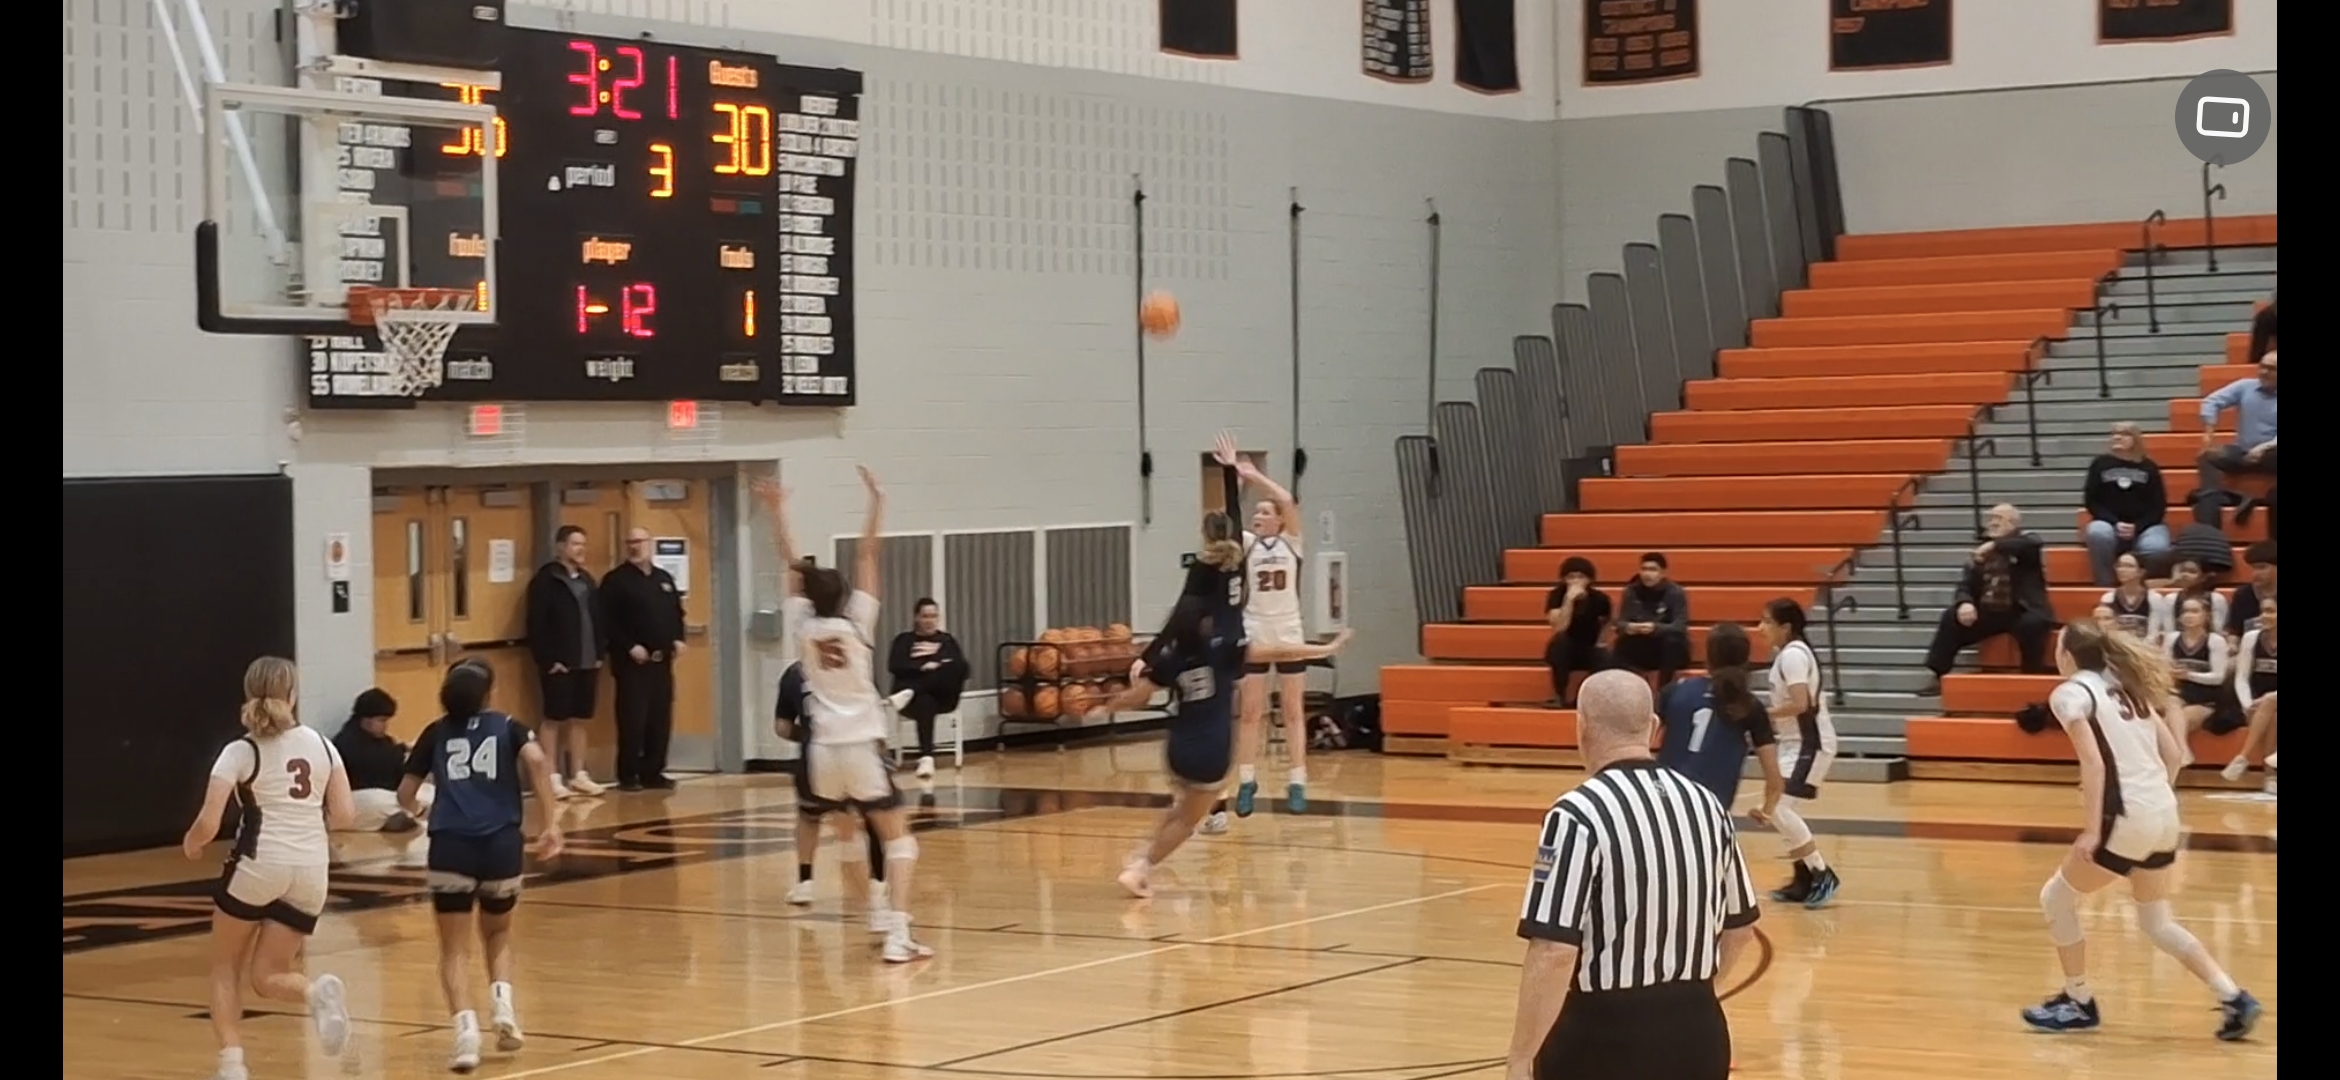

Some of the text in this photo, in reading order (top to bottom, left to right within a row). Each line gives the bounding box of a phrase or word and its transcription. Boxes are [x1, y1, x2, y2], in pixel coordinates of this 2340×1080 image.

[567, 40, 678, 119] 3:21
[712, 103, 770, 175] 30
[649, 144, 674, 197] 3
[744, 289, 755, 337] 1
[1257, 569, 1287, 592] 20
[1687, 707, 1714, 753] 1
[286, 758, 311, 800] 3
[446, 735, 497, 780] 24
